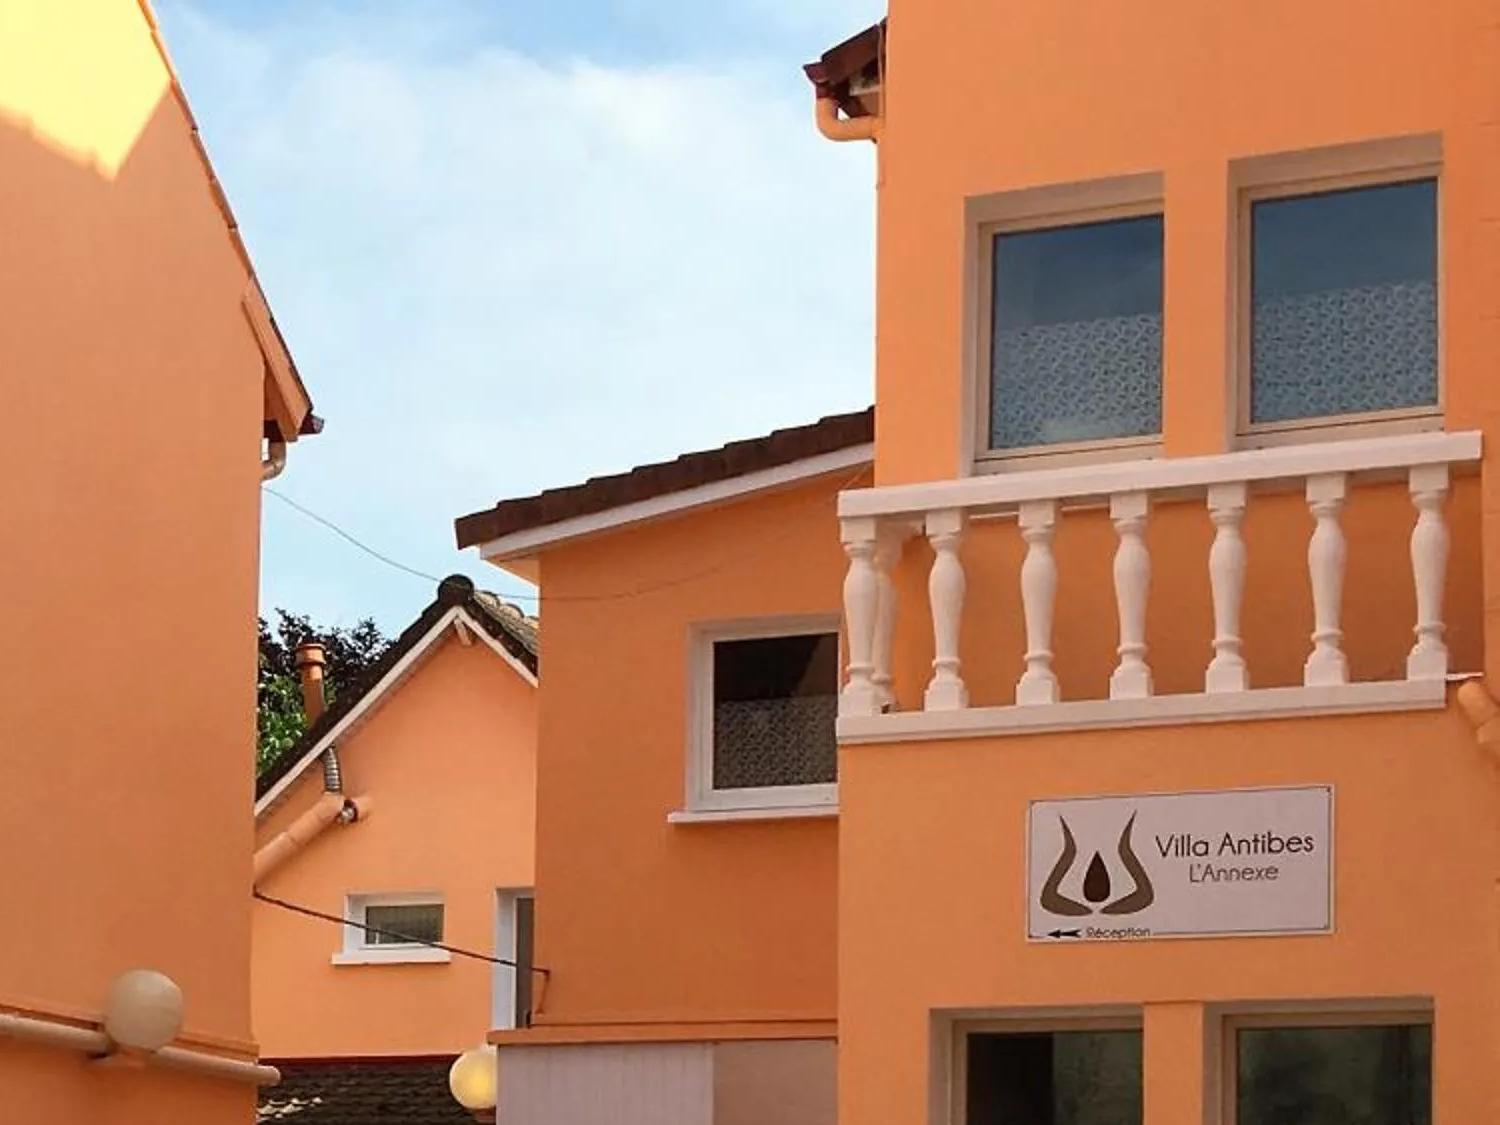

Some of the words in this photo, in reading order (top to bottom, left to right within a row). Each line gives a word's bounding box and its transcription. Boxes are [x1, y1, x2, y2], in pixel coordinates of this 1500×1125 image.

[1155, 834, 1209, 858] Villa
[1218, 831, 1314, 857] Antibes
[1189, 863, 1280, 883] L'Annexe
